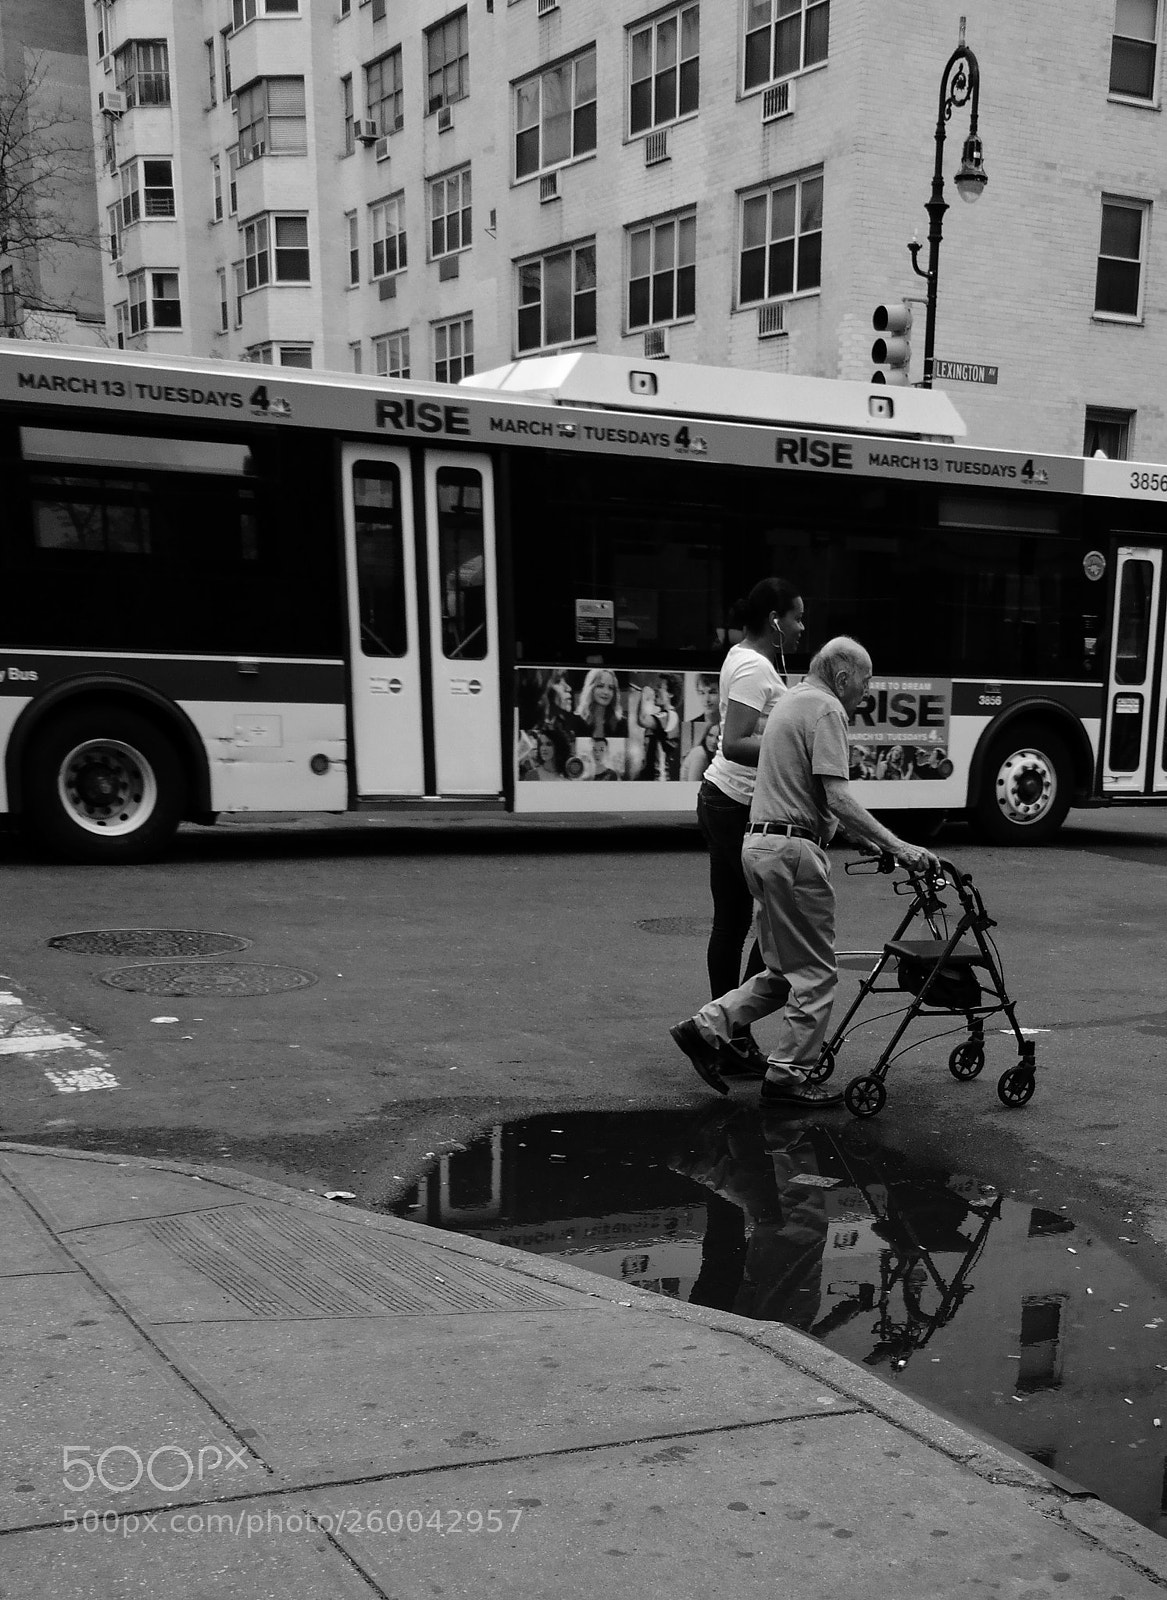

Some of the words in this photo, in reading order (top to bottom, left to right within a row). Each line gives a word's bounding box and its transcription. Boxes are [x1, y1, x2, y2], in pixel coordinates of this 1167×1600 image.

[936, 361, 985, 382] LEXINGTON
[17, 372, 98, 394] MARCH
[101, 380, 126, 397] 13
[135, 383, 243, 408] TUESDAYS
[250, 385, 270, 410] 4
[375, 399, 471, 435] RISE
[489, 417, 553, 436] MARCH
[583, 426, 670, 448] TUESDAYS
[675, 425, 691, 448] 4
[775, 437, 853, 470] RISE
[868, 453, 921, 470] MARCH
[922, 457, 939, 471] 13
[945, 460, 1017, 478] TUESDAYS
[1020, 459, 1035, 479] 4
[1130, 471, 1167, 492] 3856
[7, 667, 39, 681] Bus
[868, 681, 888, 690] ARE
[888, 681, 900, 690] TO
[901, 682, 932, 690] DREAM
[848, 690, 945, 727] RISE
[887, 733, 928, 741] TUESDAYS
[928, 730, 938, 740] 4
